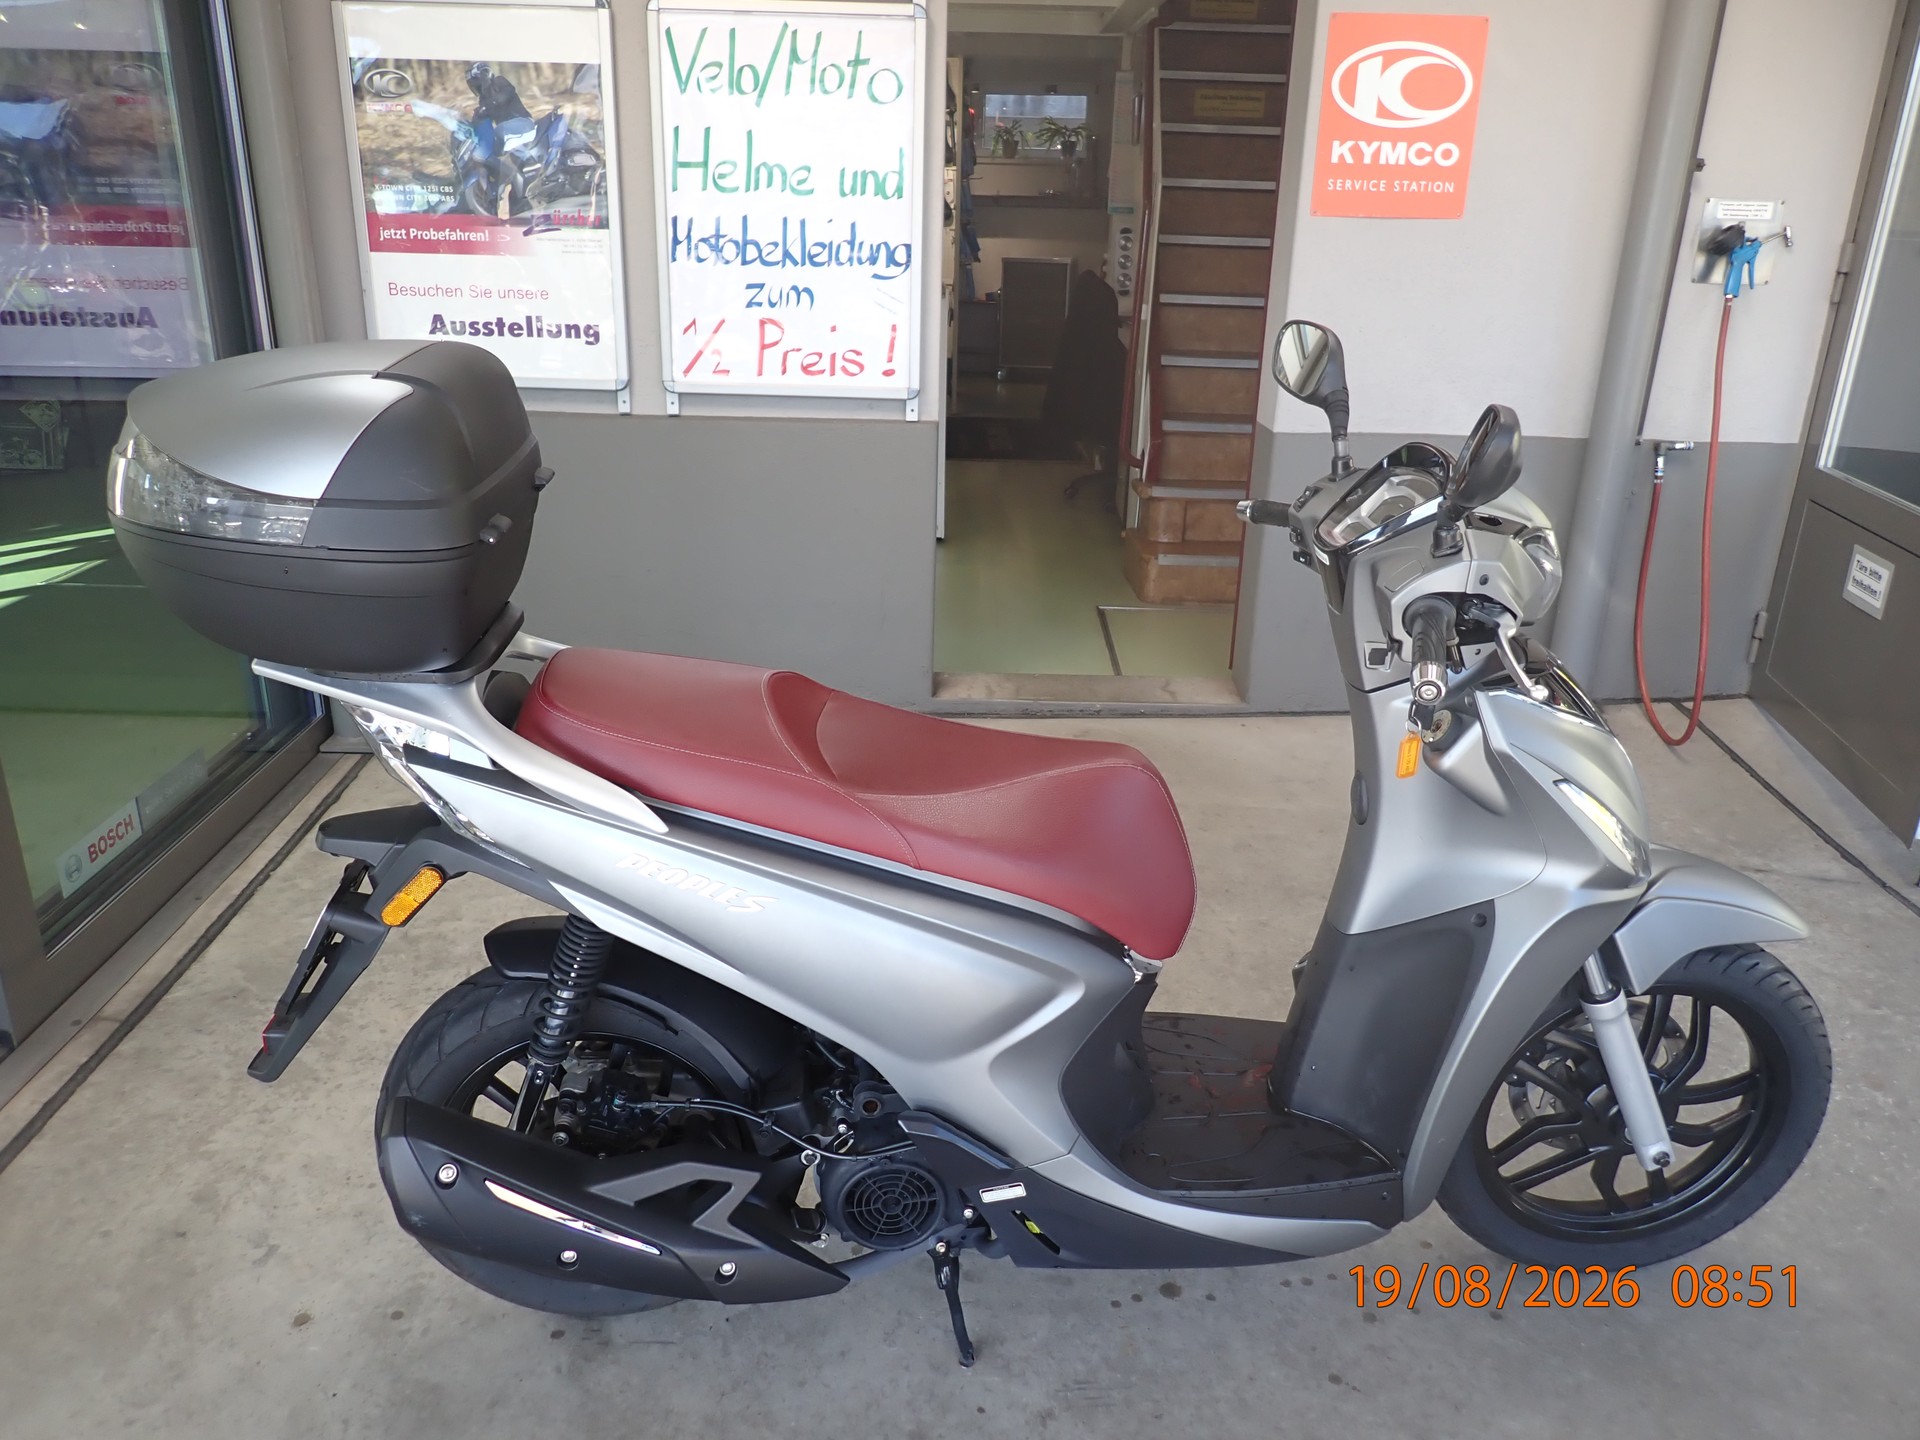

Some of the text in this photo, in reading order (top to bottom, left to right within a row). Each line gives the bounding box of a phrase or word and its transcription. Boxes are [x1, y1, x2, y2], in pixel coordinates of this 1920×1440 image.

[664, 20, 904, 108] Velo/Moto
[671, 125, 905, 201] Helme und
[1330, 140, 1461, 167] KYMCO
[1327, 178, 1455, 193] SERVICE STATION
[379, 227, 490, 243] jetzt Probefahren!
[670, 214, 912, 281] Motobekleidung
[388, 282, 550, 300] Besuchen Sie unsere
[744, 282, 815, 311] zum
[428, 313, 601, 346] Ausstellung
[87, 813, 135, 864] BOSCH
